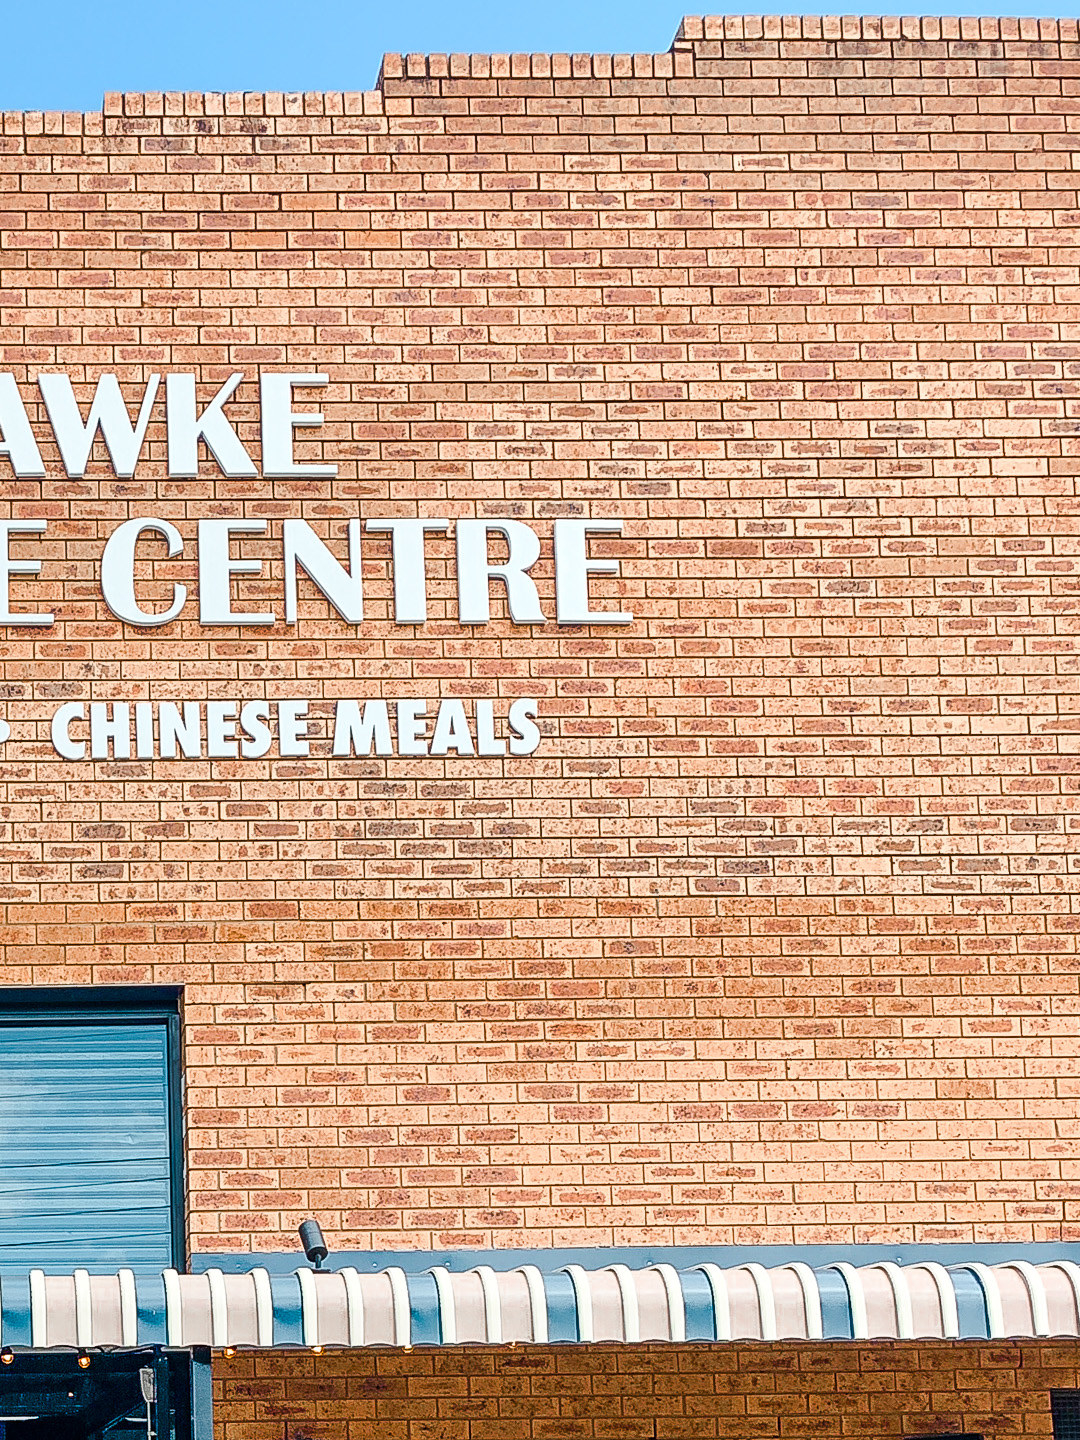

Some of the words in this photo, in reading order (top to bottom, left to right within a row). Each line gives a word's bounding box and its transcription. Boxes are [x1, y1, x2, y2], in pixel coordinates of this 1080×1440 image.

[101, 516, 635, 624] CENTRE
[51, 699, 313, 760] CHINESE
[332, 697, 542, 758] MEALS
